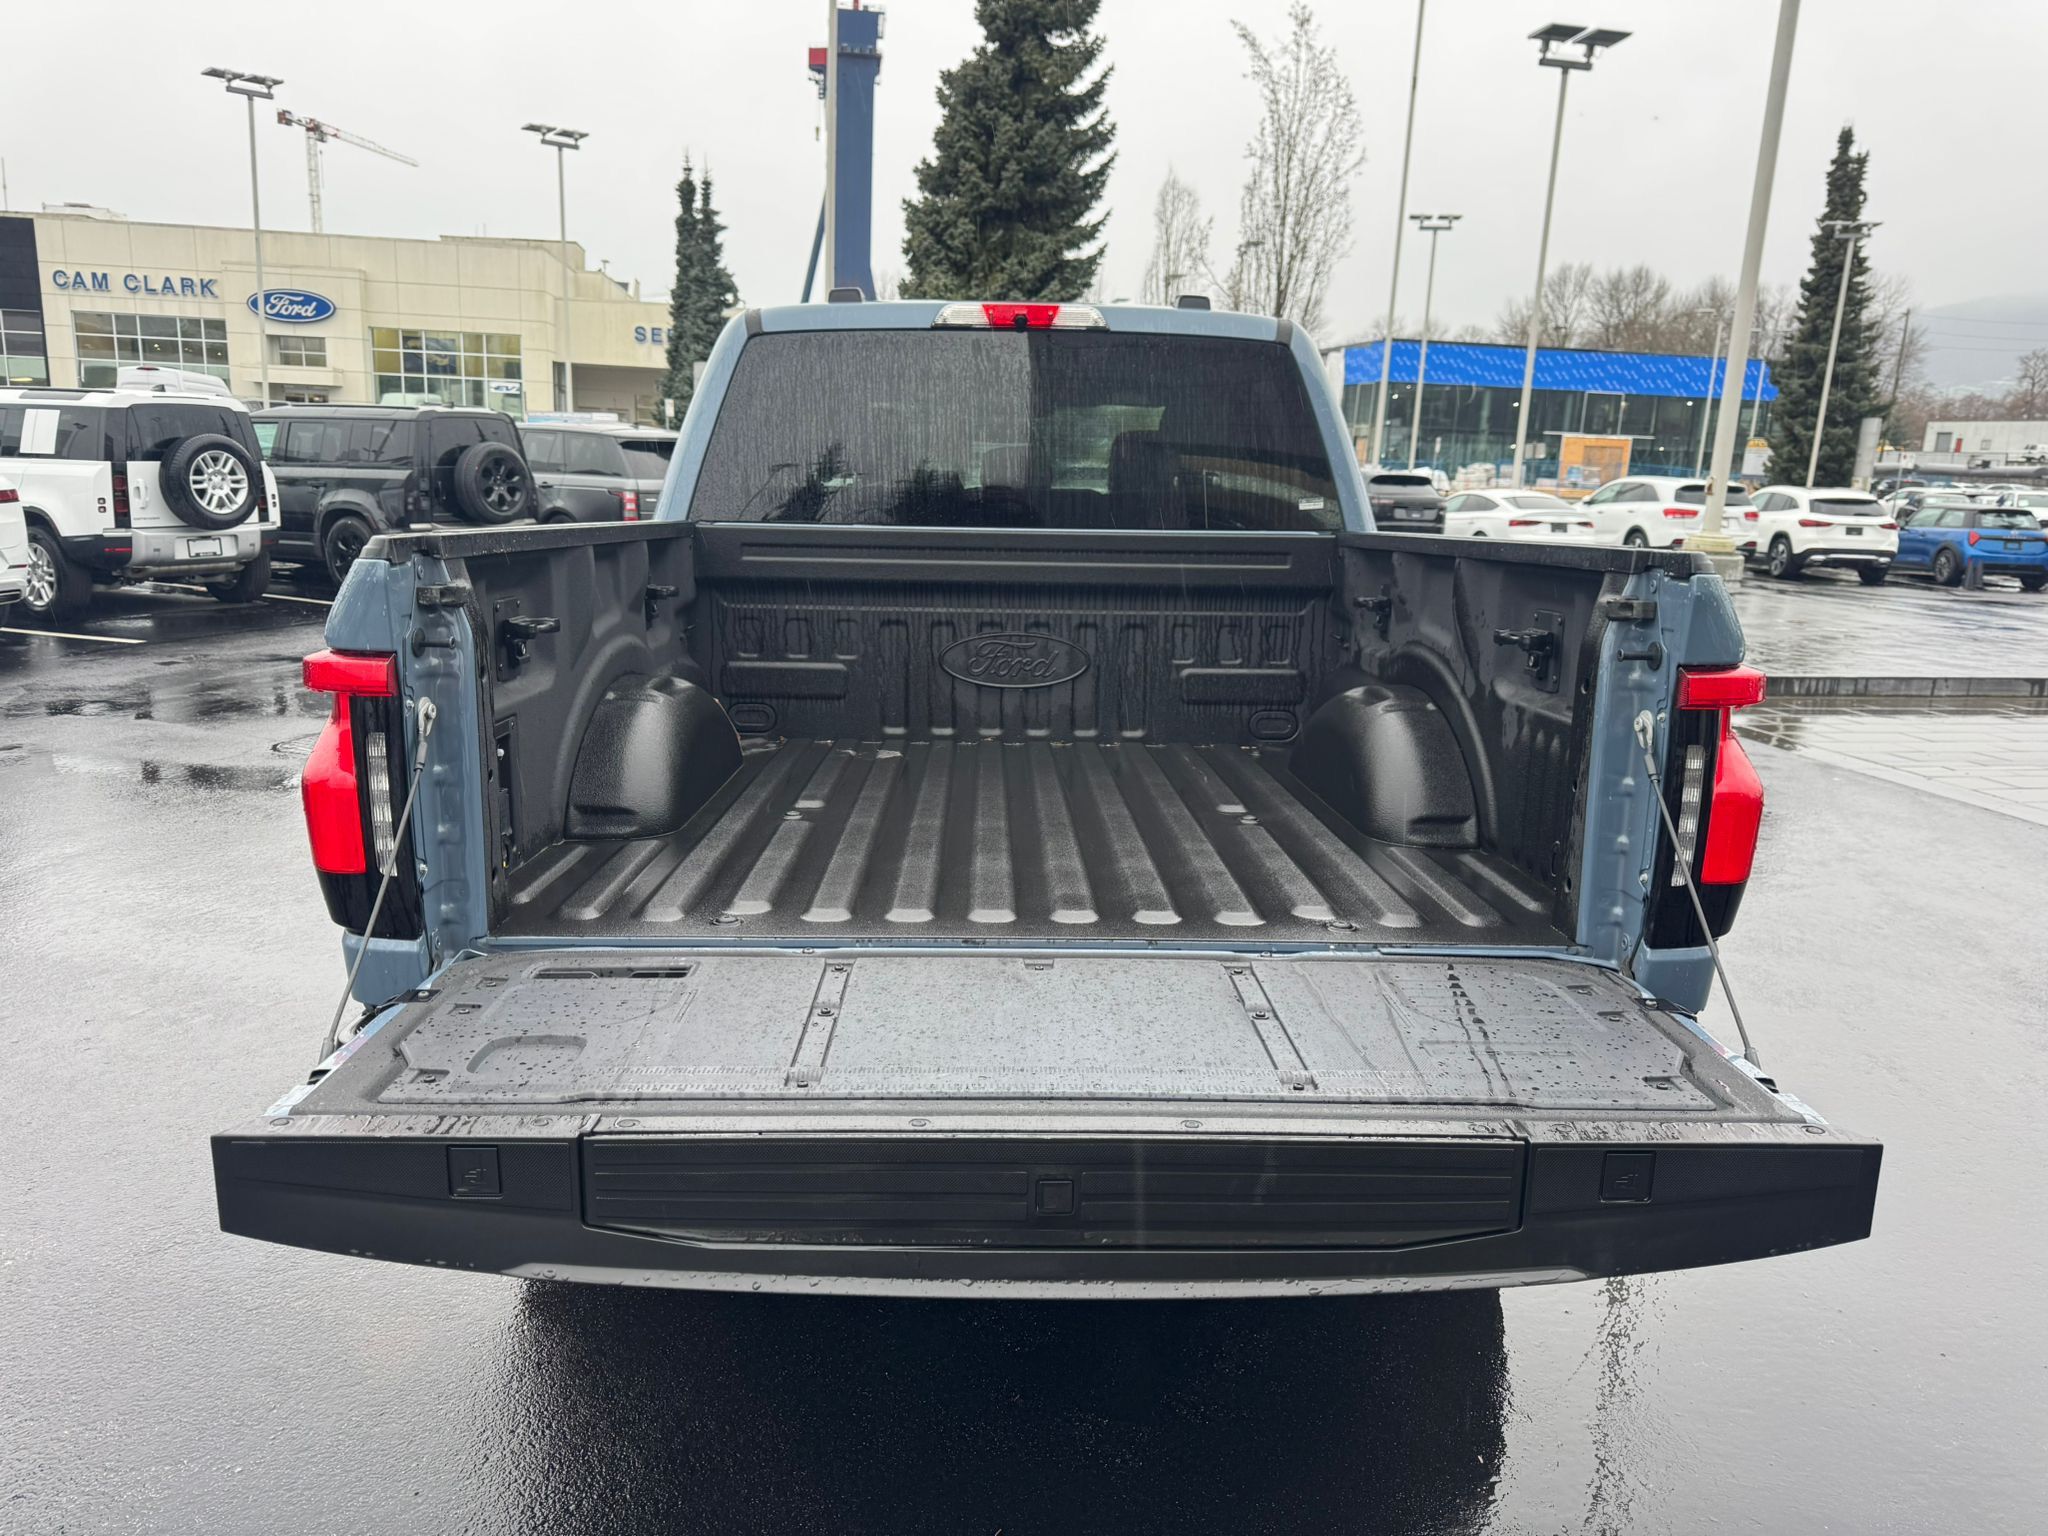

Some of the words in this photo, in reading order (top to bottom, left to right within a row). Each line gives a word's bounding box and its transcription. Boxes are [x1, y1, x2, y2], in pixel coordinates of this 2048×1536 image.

[52, 270, 111, 291] CAM
[123, 273, 218, 297] CLARK
[265, 293, 317, 317] Ford
[968, 639, 1060, 677] Ford
